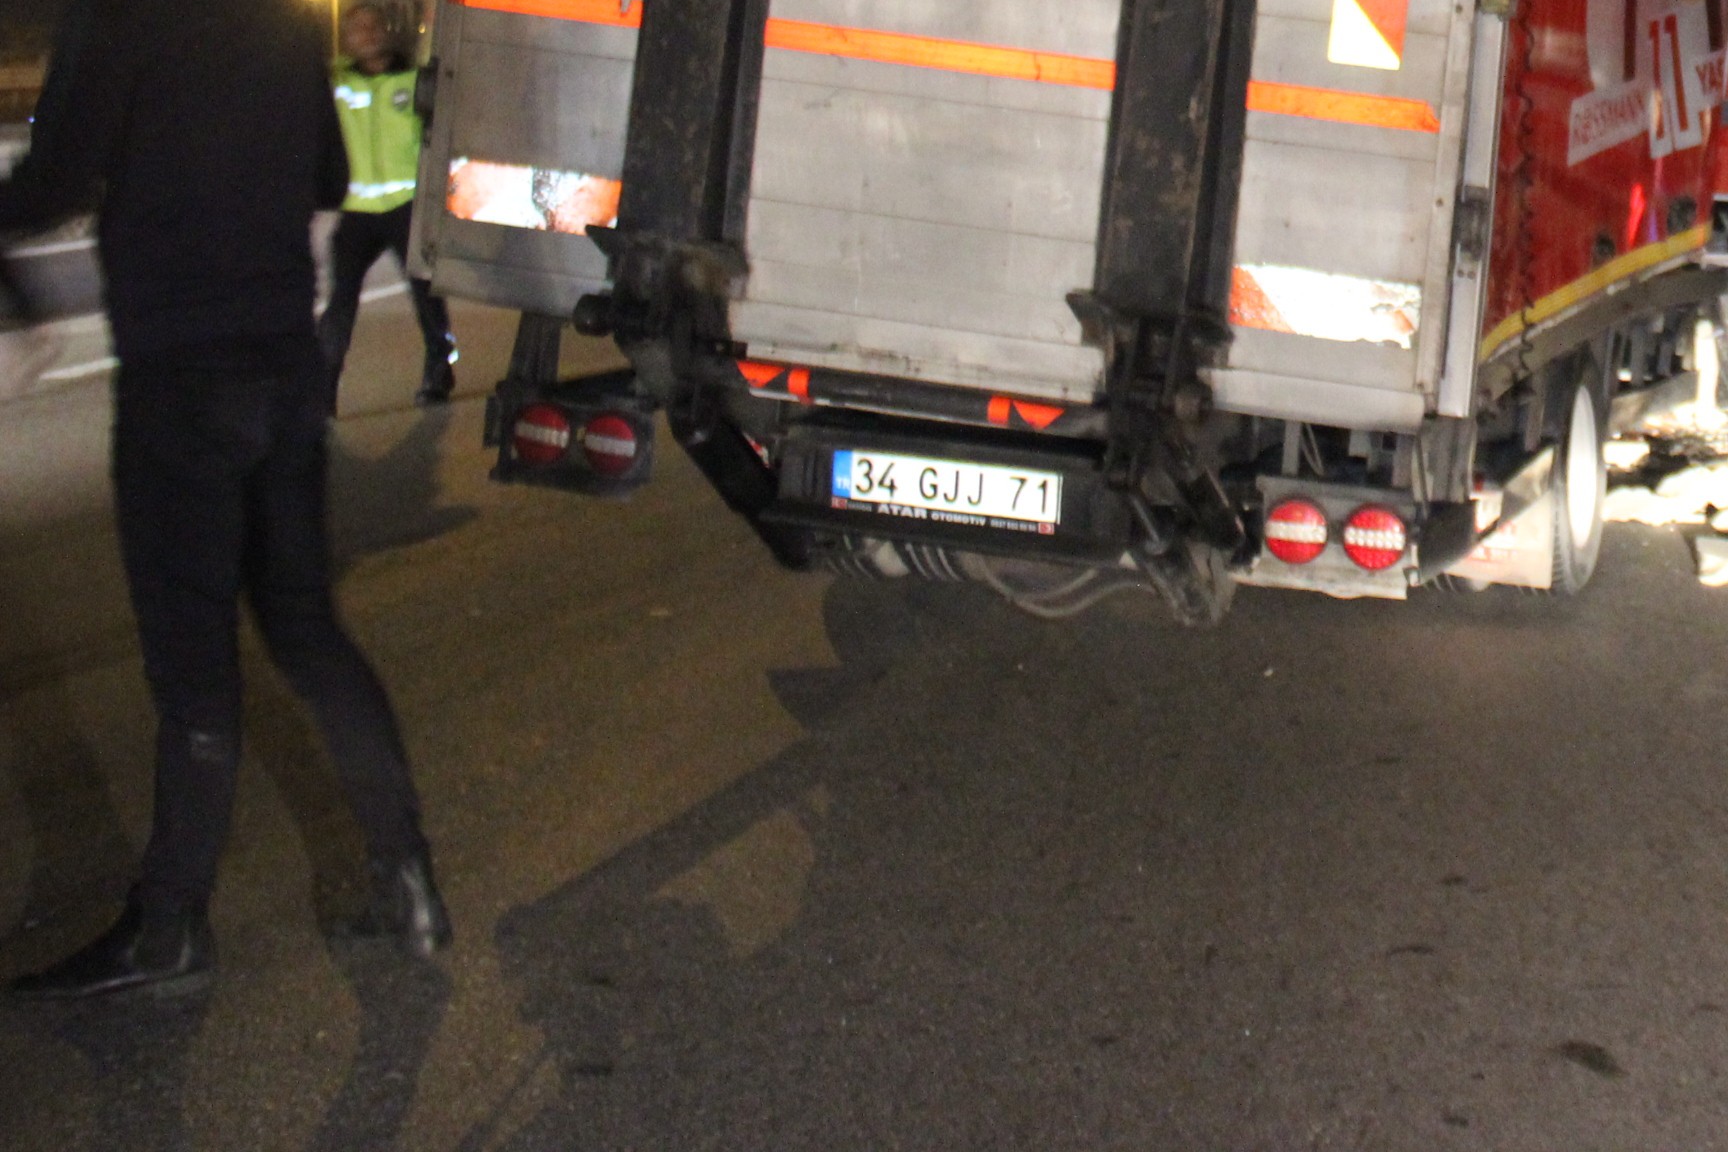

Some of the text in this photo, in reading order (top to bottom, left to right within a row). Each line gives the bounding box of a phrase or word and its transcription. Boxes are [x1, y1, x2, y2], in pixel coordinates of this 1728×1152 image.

[855, 458, 1048, 515] 34 GJJ 71
[877, 503, 928, 519] ATAR
